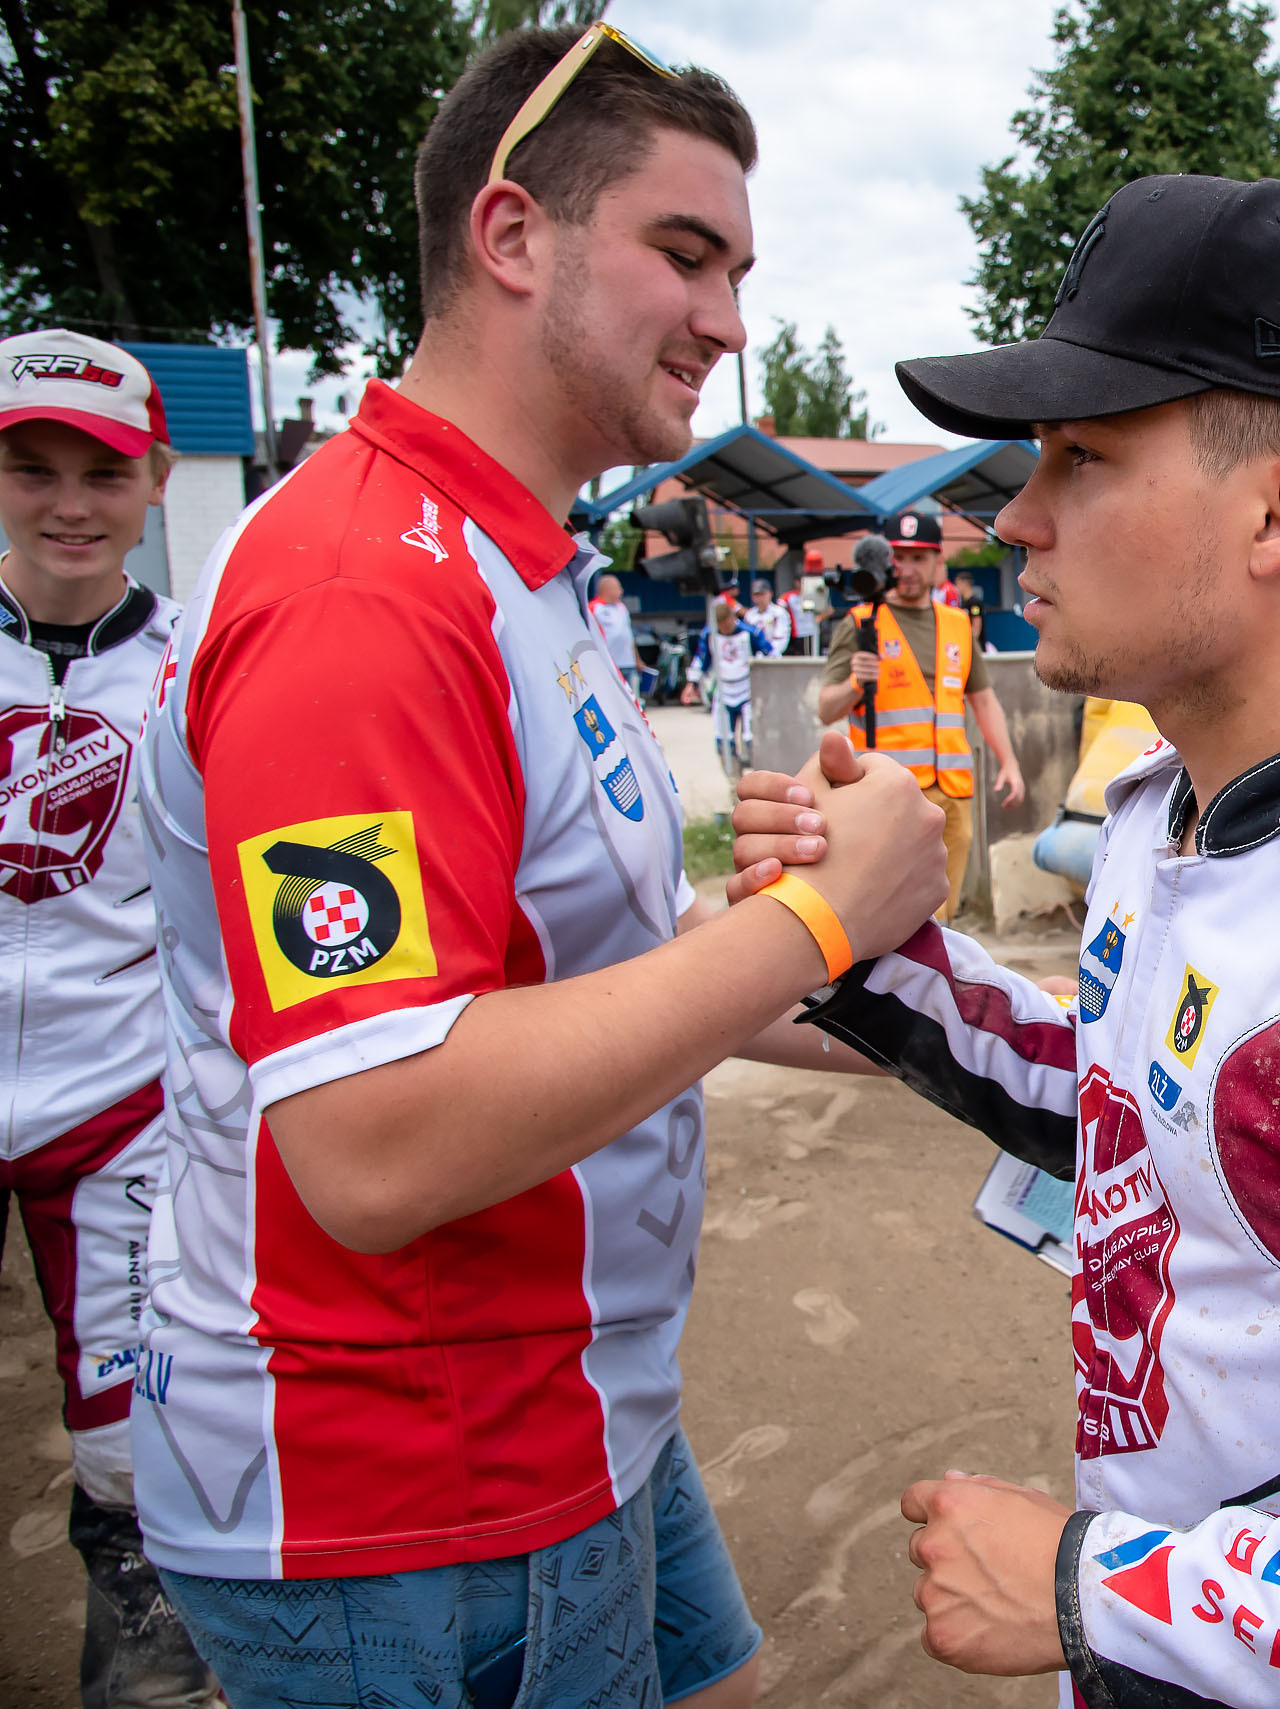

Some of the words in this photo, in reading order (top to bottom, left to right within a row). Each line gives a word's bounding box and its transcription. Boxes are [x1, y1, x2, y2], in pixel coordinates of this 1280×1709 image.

[0, 735, 110, 806] OKOMOTIV
[50, 760, 120, 801] DAUGAVPILS
[308, 937, 380, 973] PZM
[128, 1240, 141, 1286] ANNO
[1088, 1217, 1172, 1272] DAUGAVPILS
[1134, 1243, 1160, 1261] CLUB
